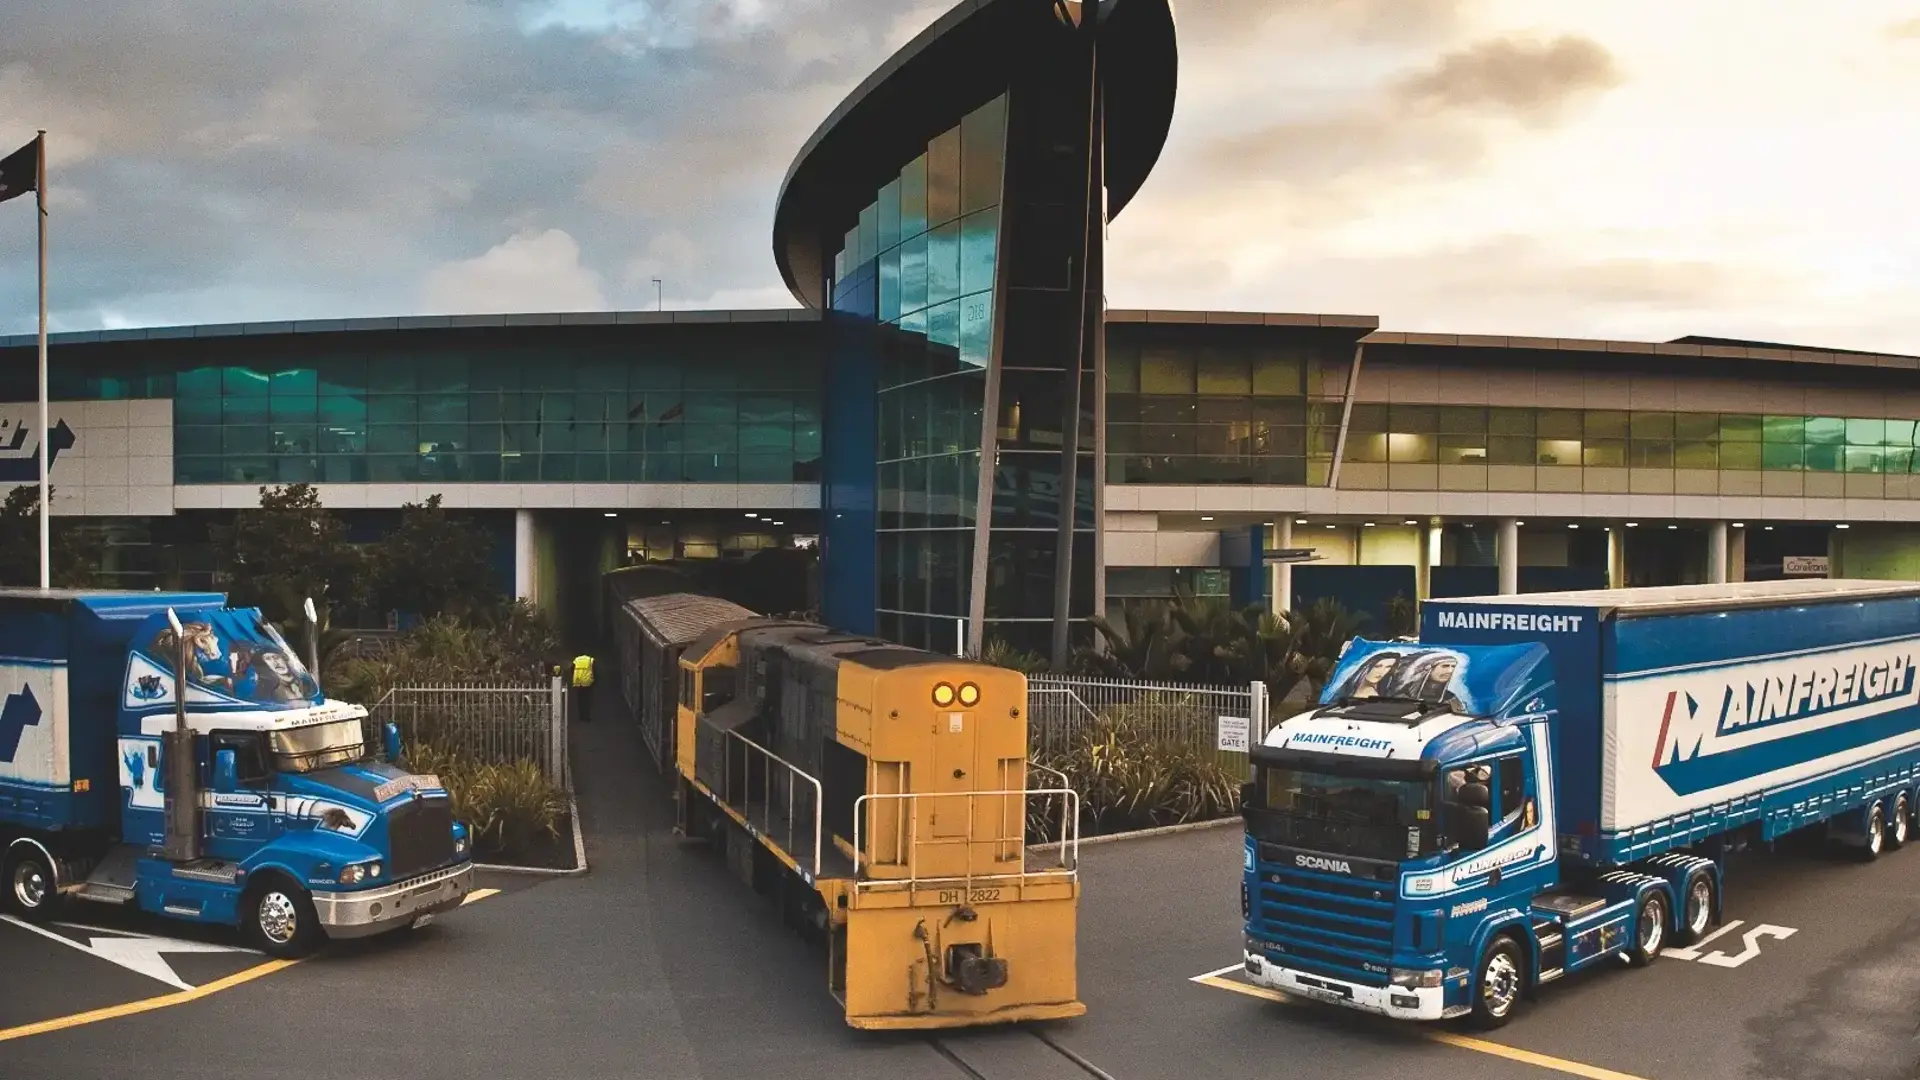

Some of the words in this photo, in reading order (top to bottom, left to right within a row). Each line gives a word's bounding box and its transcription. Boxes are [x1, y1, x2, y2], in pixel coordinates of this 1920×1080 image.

[1438, 611, 1583, 632] MAINFREIGHT
[1221, 738, 1240, 747] GATE
[1292, 732, 1391, 750] MAINFREIGHT
[1295, 854, 1352, 874] SCANIA
[939, 890, 958, 903] DH
[970, 889, 1000, 902] 2822
